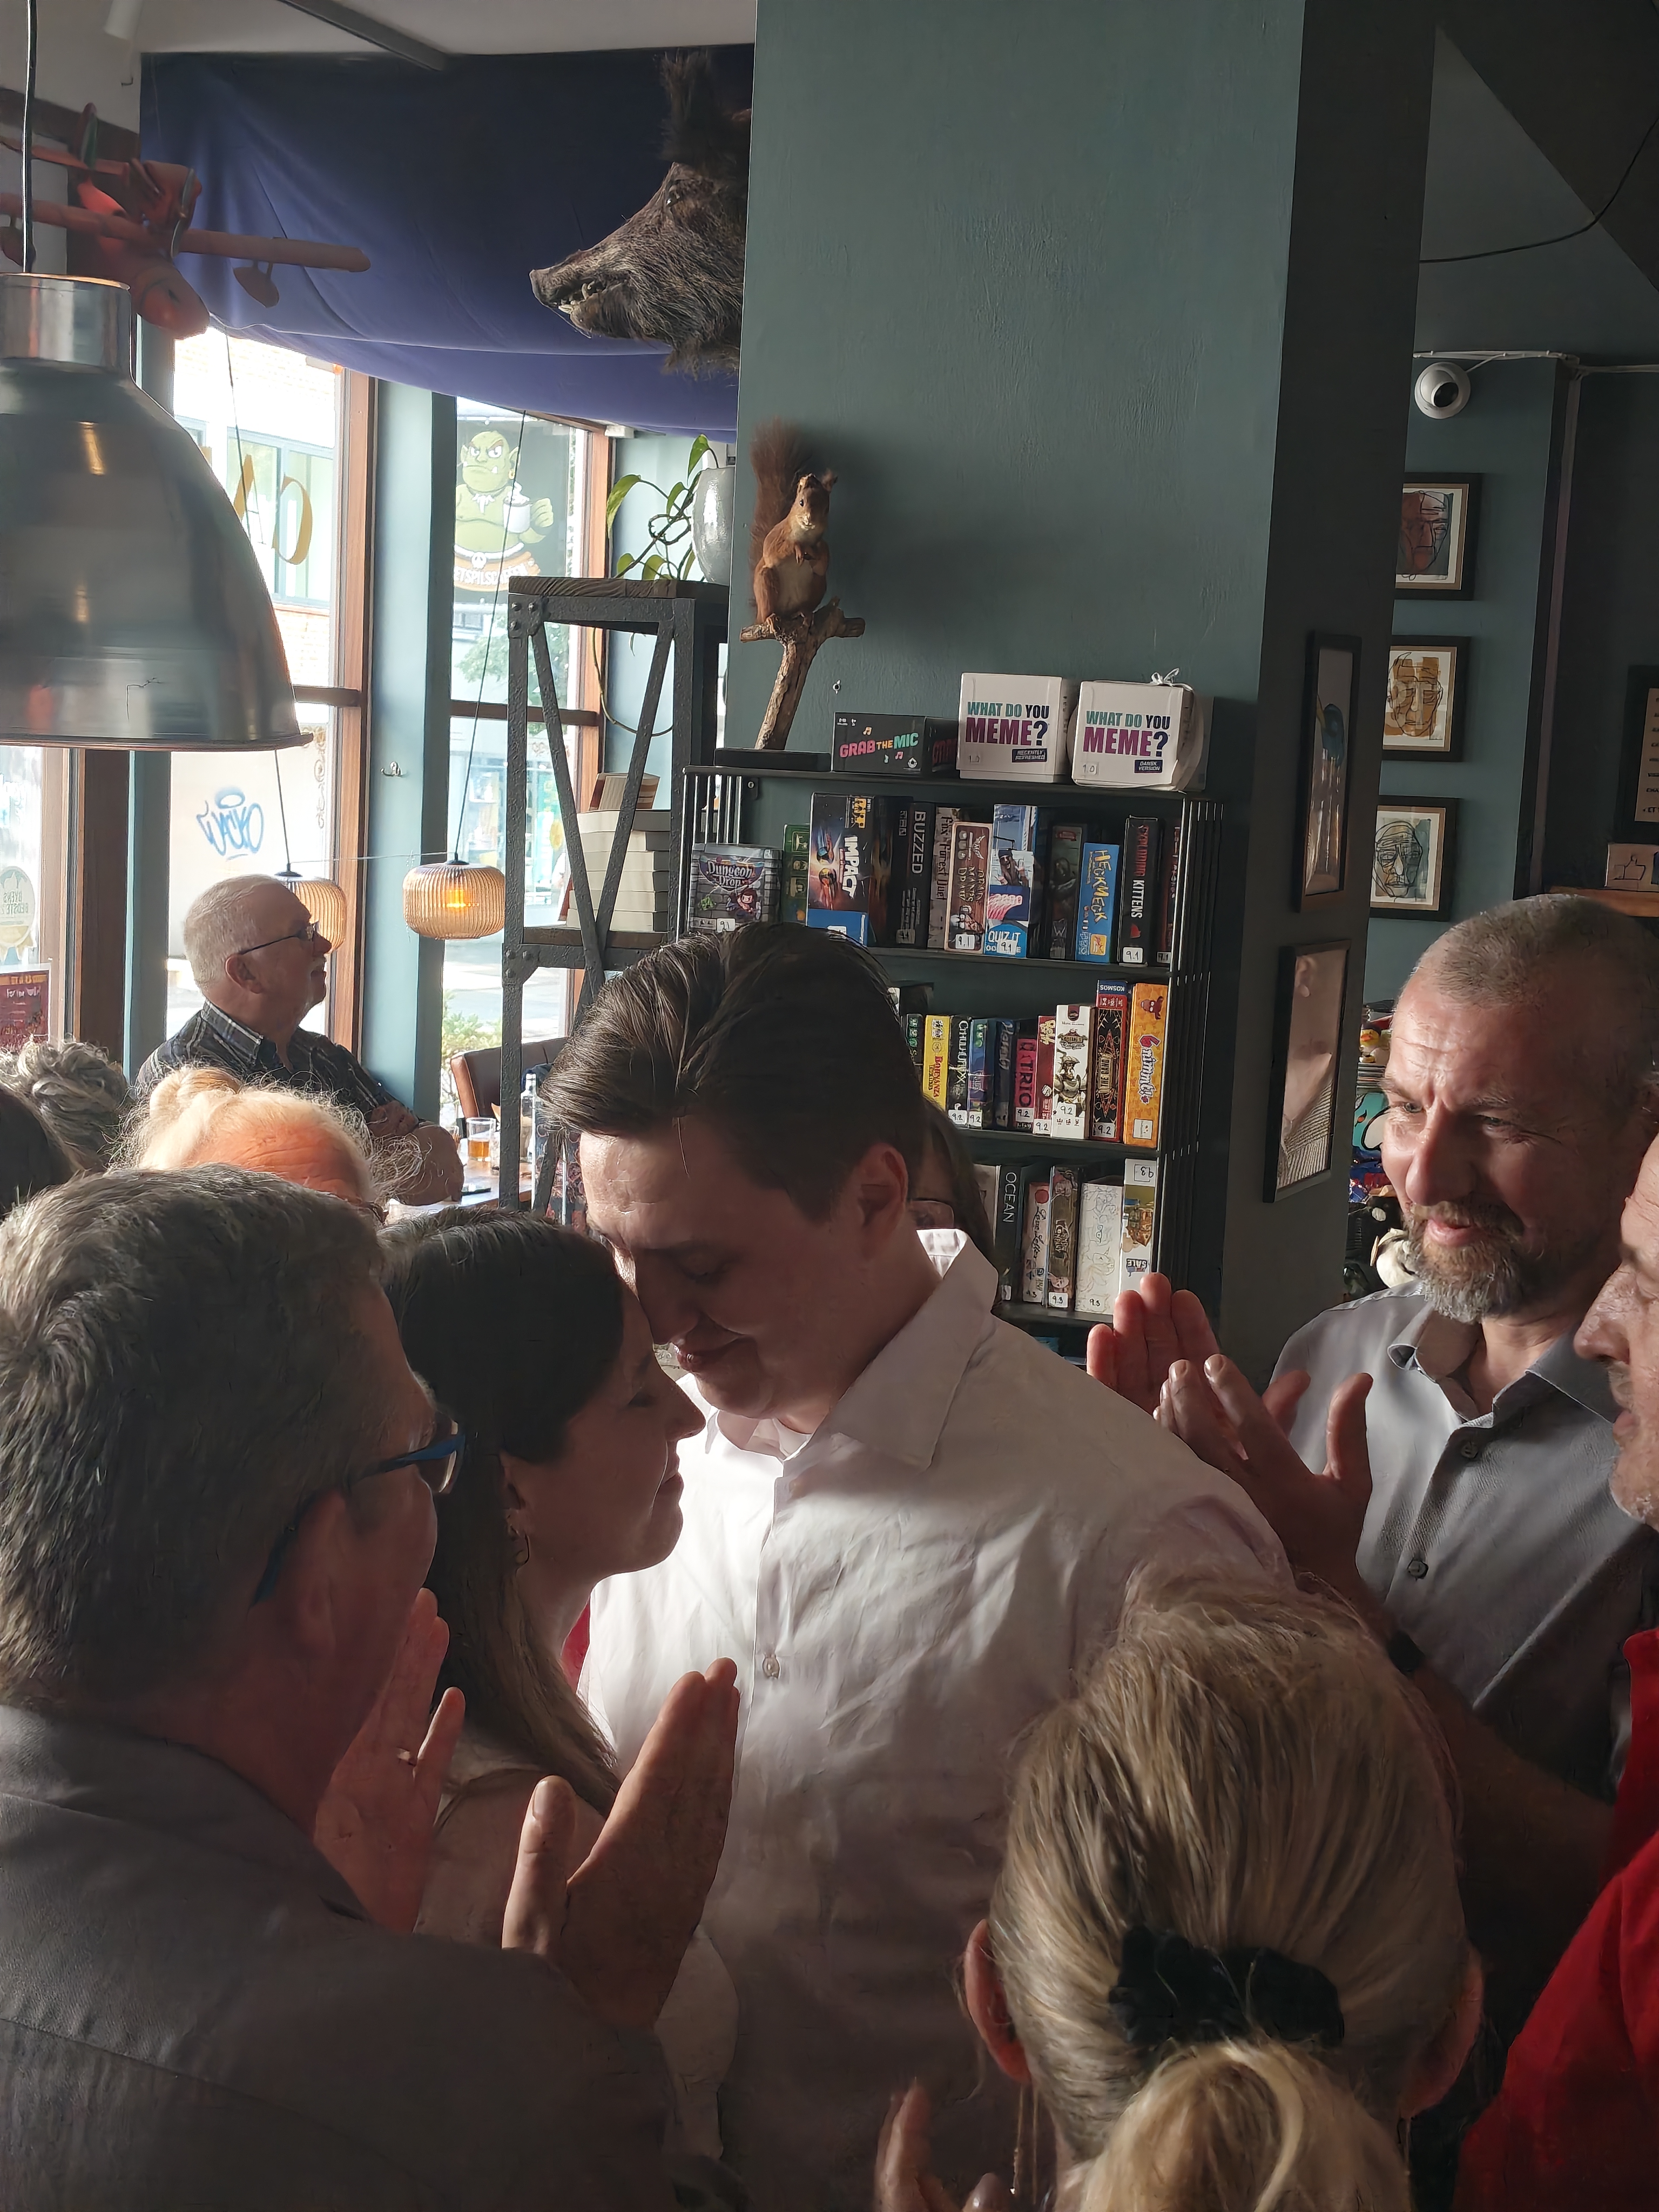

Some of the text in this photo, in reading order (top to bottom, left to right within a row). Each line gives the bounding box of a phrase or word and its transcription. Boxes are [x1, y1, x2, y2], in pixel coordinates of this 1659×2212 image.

[967, 702, 1049, 719] WHAT DO YOU
[1086, 711, 1170, 729] WHAT DO YOU
[966, 717, 1048, 746] MEME?
[840, 732, 919, 758] GRAB THE MIC
[1083, 726, 1169, 757] MEME?
[912, 811, 927, 874] BUZZED
[842, 836, 860, 899] IMPACT
[937, 844, 950, 876] Forest
[707, 861, 753, 879] Dungeon
[719, 876, 741, 888] Drop
[936, 880, 948, 901] Duet
[957, 867, 968, 901] DRAW
[1090, 849, 1112, 924] HECKMECK
[1131, 879, 1145, 918] KITTENS
[959, 935, 970, 948] 9.1
[988, 930, 1021, 942] QUIZ IT
[1001, 941, 1011, 953] 9.1
[1125, 950, 1139, 961] 9.1
[1139, 1034, 1161, 1097] 6 nimmt!
[1019, 1060, 1034, 1108] TRIO
[1100, 1077, 1110, 1088] THE
[1061, 1105, 1073, 1115] 9.2
[1035, 1123, 1049, 1131] 9.2
[1097, 1125, 1111, 1135] 9.2
[1003, 1172, 1017, 1222] OCEAN
[1127, 1259, 1147, 1268] SALE
